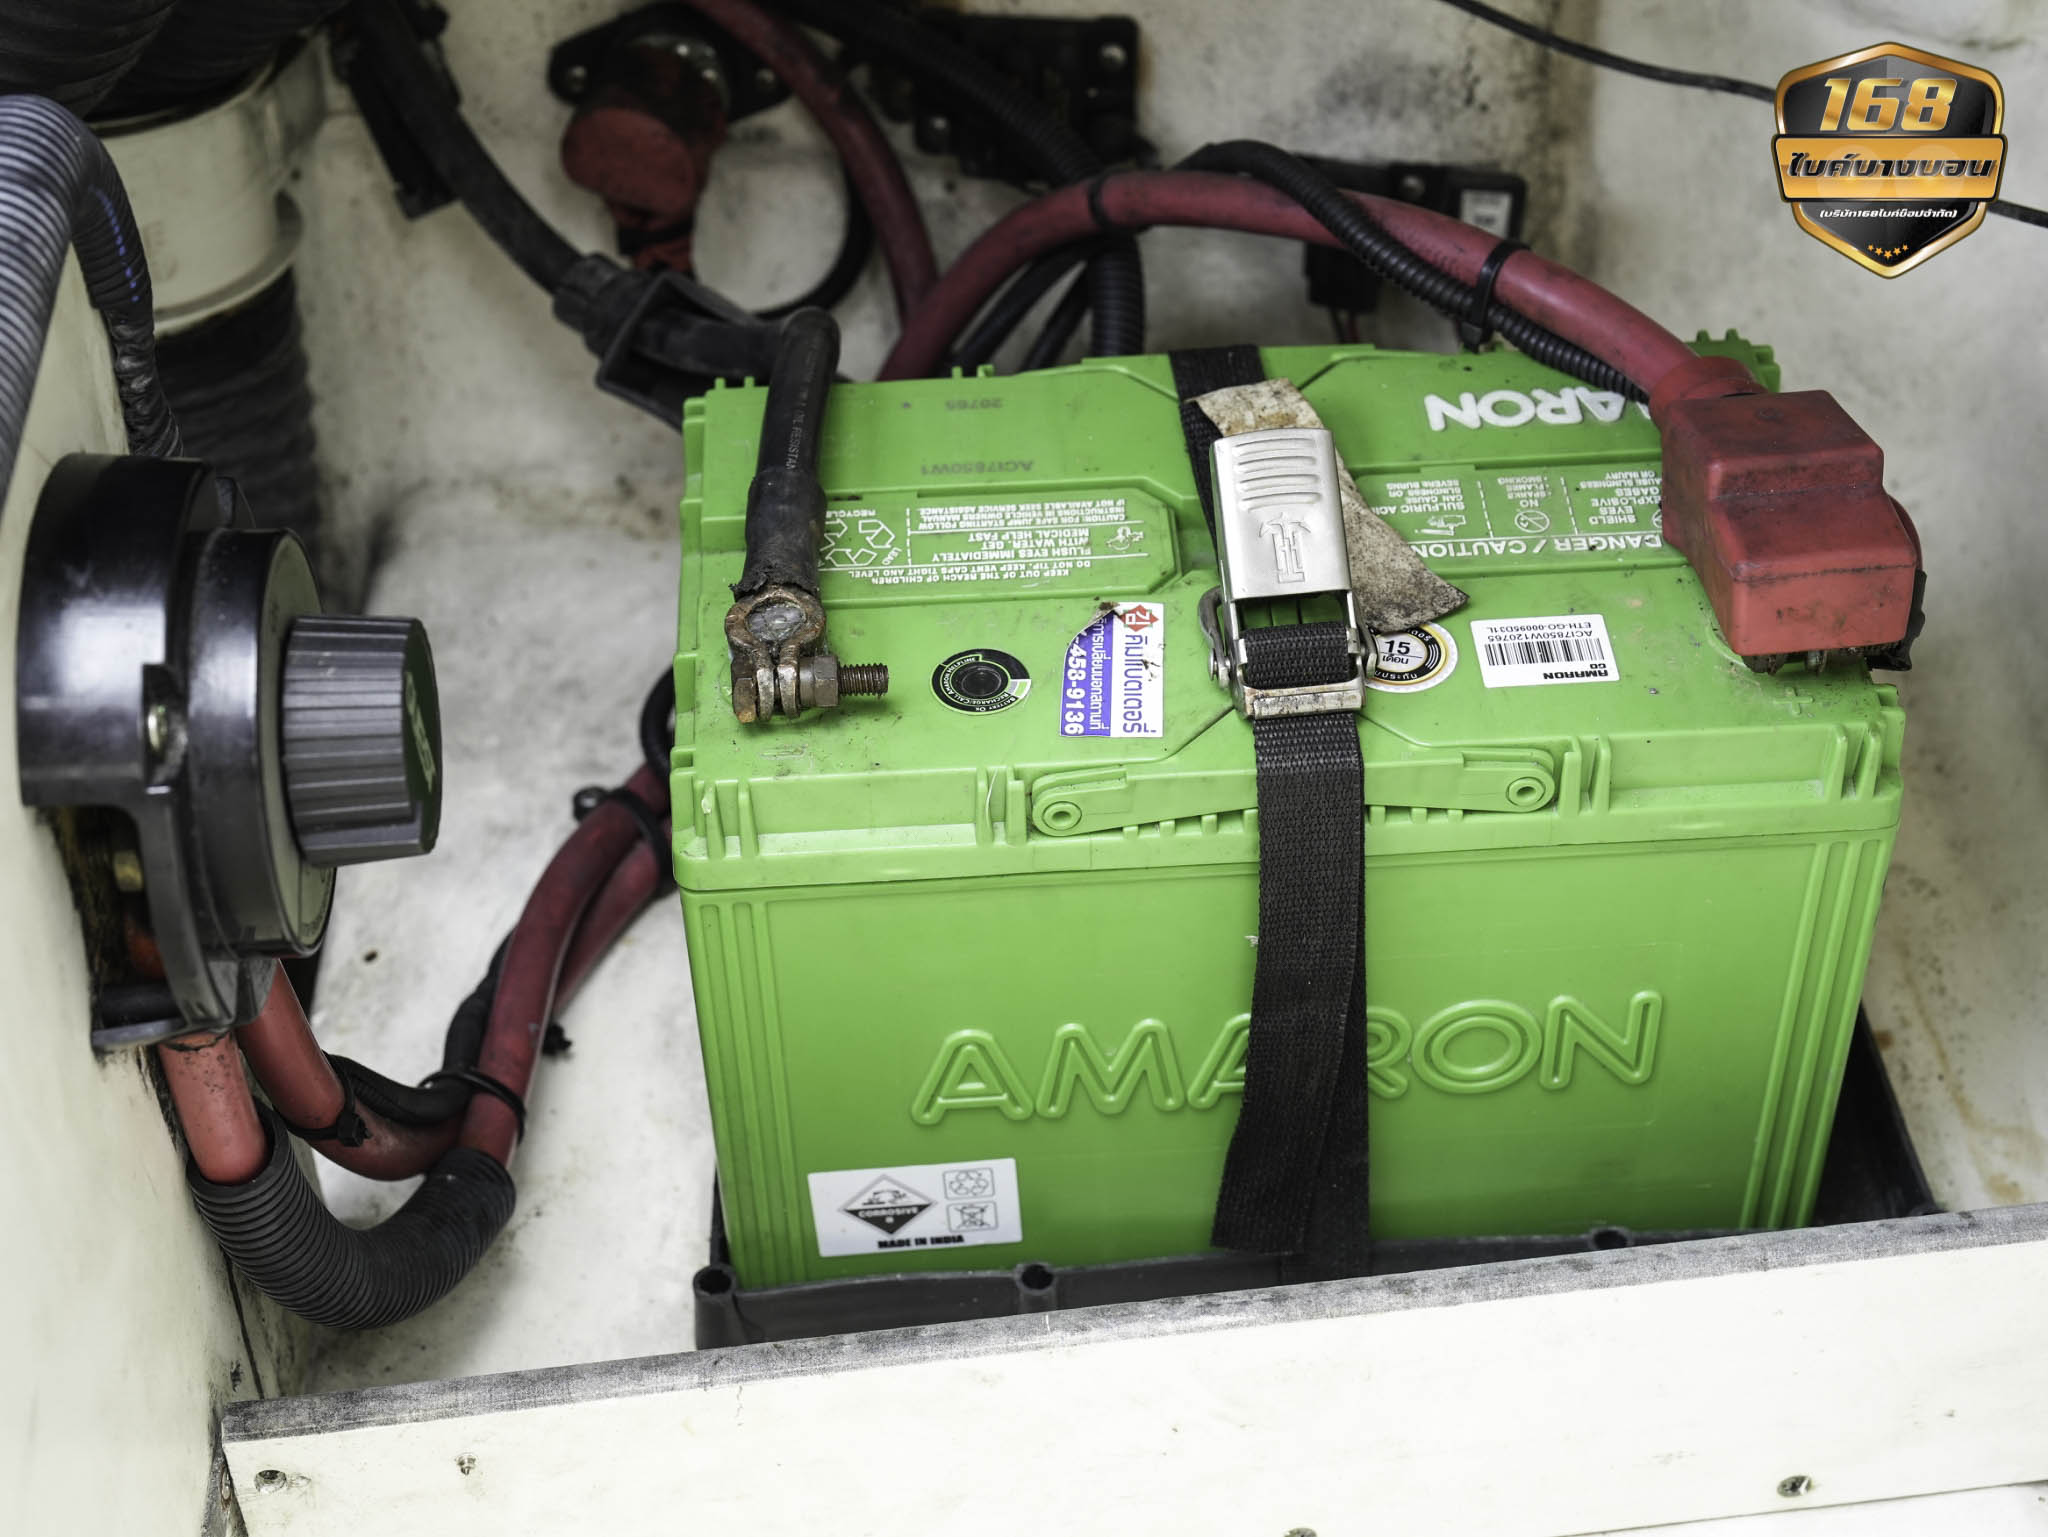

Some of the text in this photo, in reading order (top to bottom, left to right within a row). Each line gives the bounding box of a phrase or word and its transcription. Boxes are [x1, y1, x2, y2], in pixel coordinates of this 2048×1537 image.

[1424, 386, 1651, 431] ARON
[1634, 478, 1662, 486] AUSE
[1615, 487, 1660, 496] GASES
[1591, 496, 1661, 506] EXPLOSIVE
[1401, 502, 1465, 512] SULFURIC
[1599, 505, 1633, 514] EYES
[1588, 514, 1636, 524] SHIELD
[919, 521, 957, 529] FOLLOW
[968, 528, 1089, 541] MEDICAL HELP FAST
[981, 541, 1004, 549] GET
[1058, 537, 1089, 545] WITH
[1554, 534, 1662, 550] DANGER
[931, 547, 1091, 561] FLUSH EYES IMMEDIATELY
[907, 567, 937, 575] TIGHT
[941, 565, 968, 573] CAPS
[969, 564, 997, 572] VENT
[980, 572, 1000, 580] THE
[1385, 640, 1411, 655] 15
[1382, 654, 1409, 665] เดือน
[1089, 617, 1112, 730] ริการเปลี่ยนนอกสถานที่
[1543, 670, 1609, 680] AMARON
[1064, 632, 1088, 735] -458-9136
[858, 1206, 919, 1219] CORROSIVE
[877, 1235, 964, 1249] MADE IN INDIA
